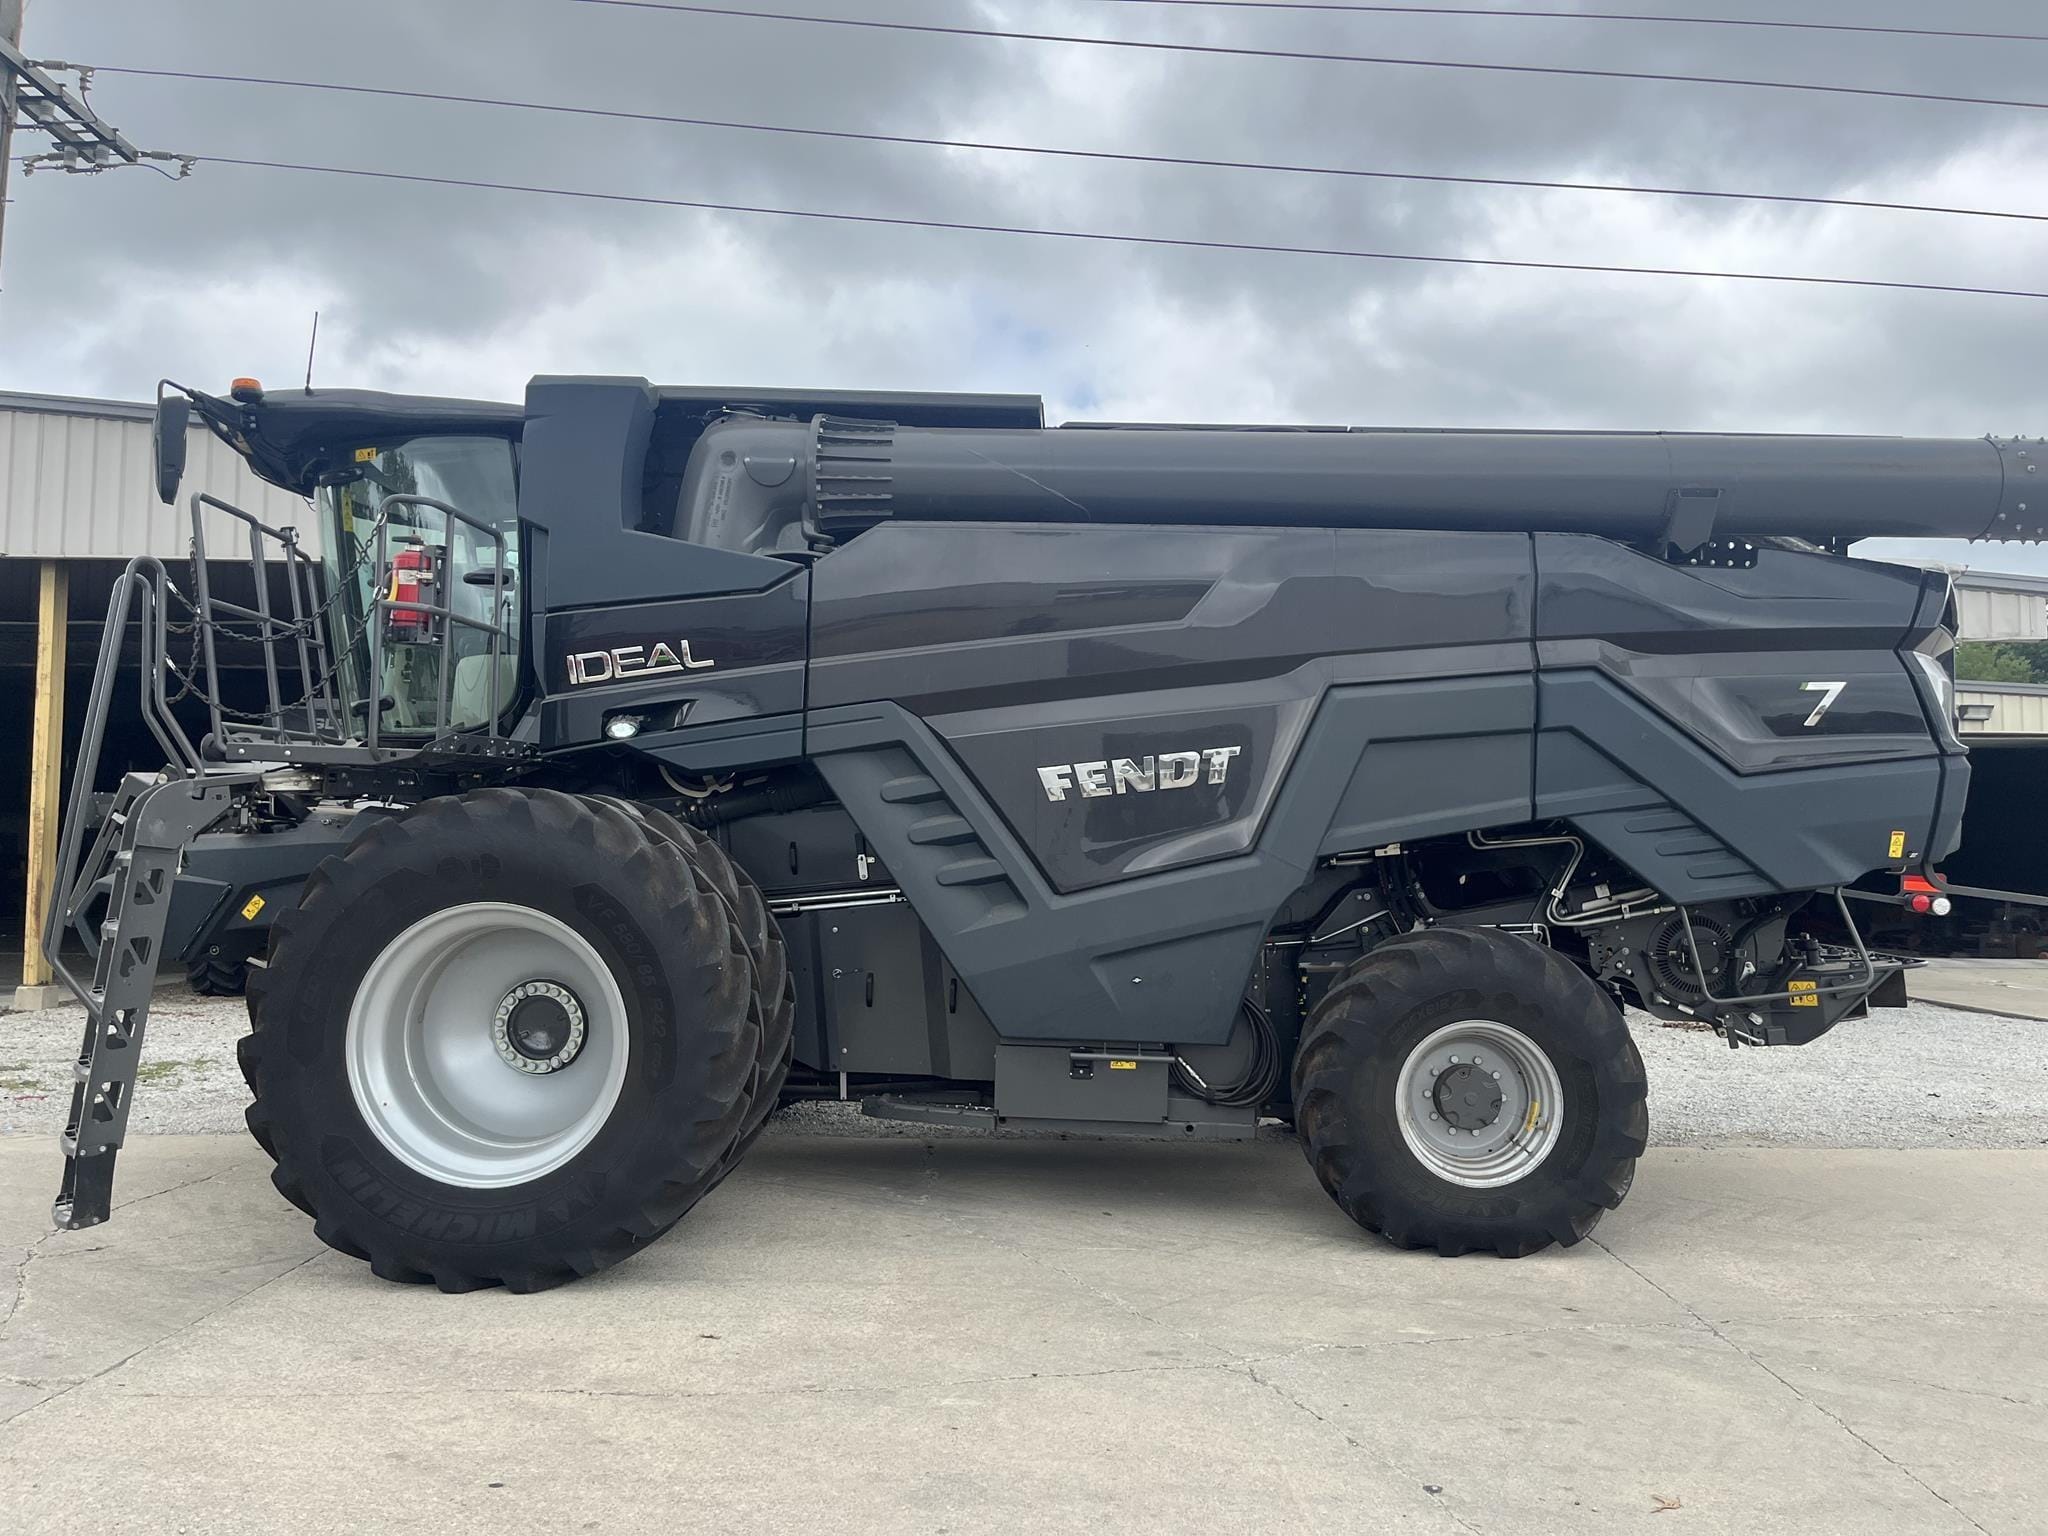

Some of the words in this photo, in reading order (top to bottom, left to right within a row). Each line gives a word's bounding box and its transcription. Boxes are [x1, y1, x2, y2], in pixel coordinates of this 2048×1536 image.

[567, 640, 715, 684] IDEAL
[1800, 681, 1847, 727] 7
[1037, 746, 1242, 802] FENDT
[332, 1154, 538, 1242] MICHELIN
